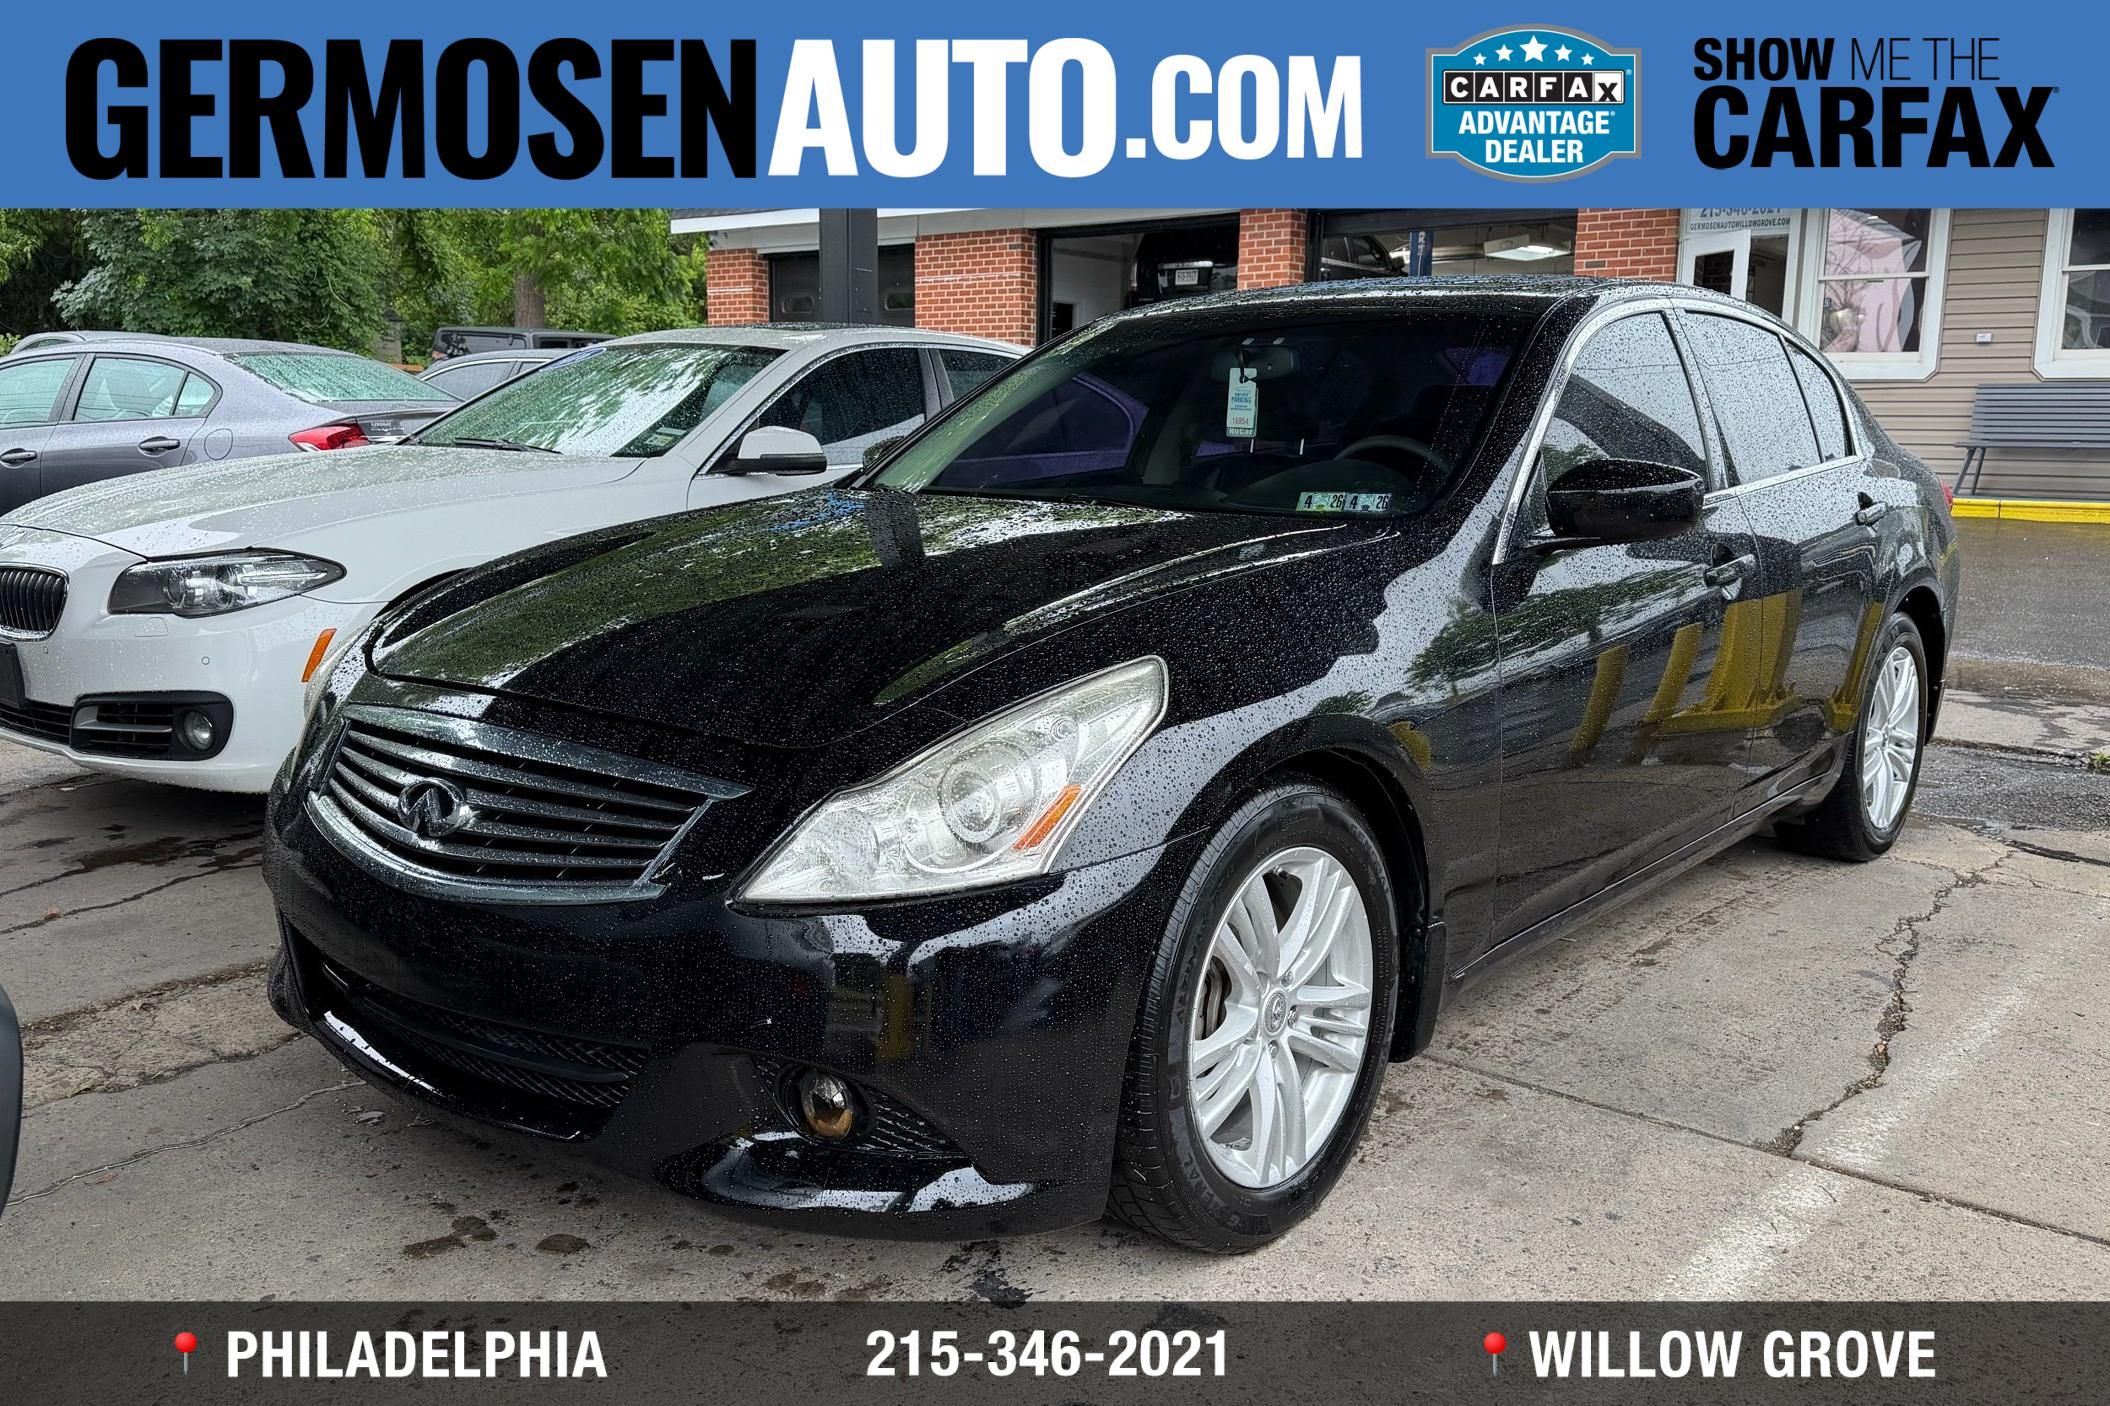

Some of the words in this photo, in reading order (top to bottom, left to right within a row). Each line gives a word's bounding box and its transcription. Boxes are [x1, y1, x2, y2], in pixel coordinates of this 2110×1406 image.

[1690, 217, 1791, 231] GERMOSENAUTOWILLOWGROVE.COM
[1304, 494, 1313, 509] 4
[1329, 494, 1344, 509] 26
[1349, 495, 1359, 509] 4
[1375, 495, 1390, 509] 26
